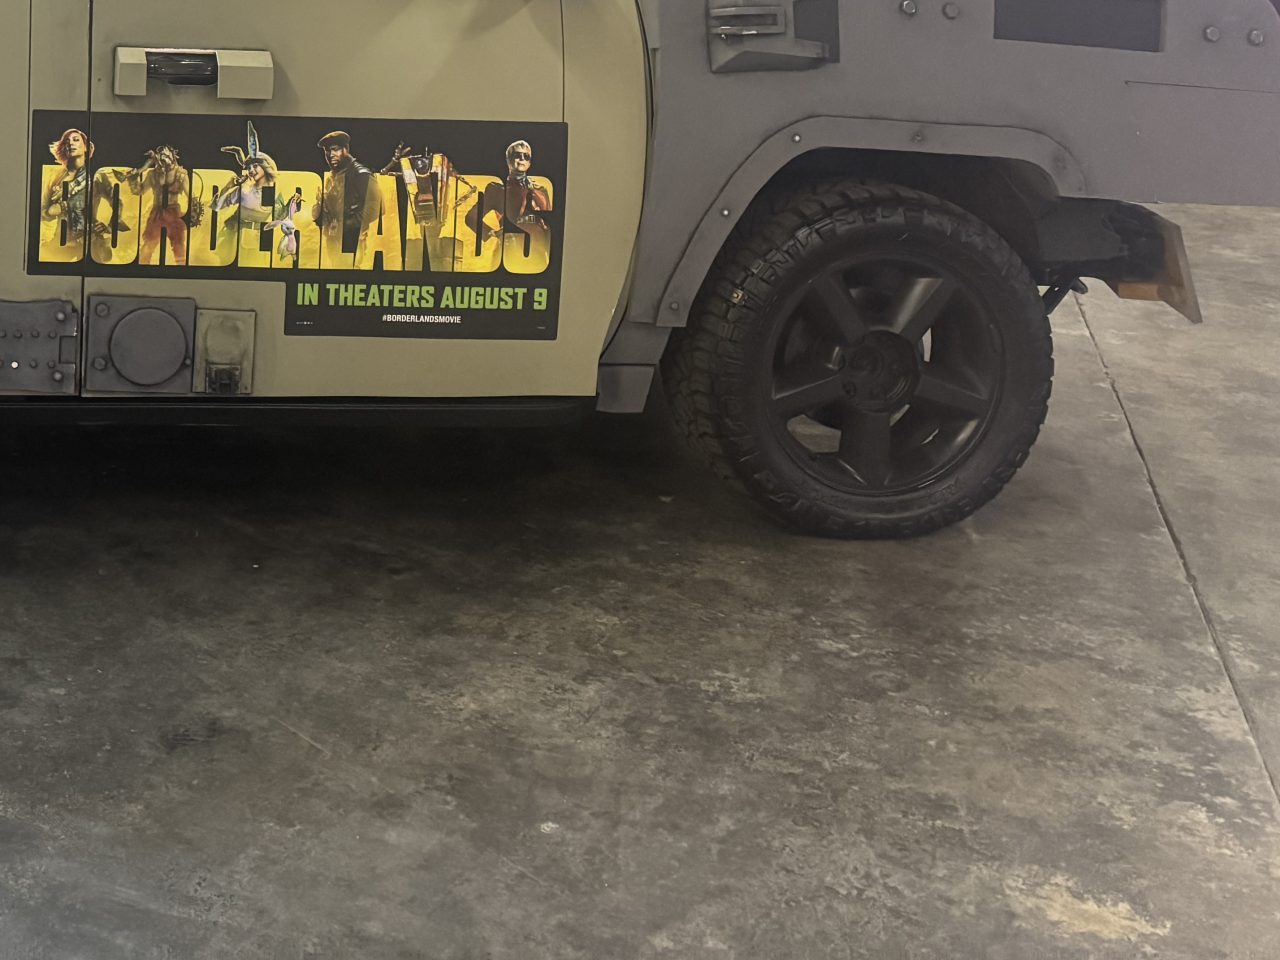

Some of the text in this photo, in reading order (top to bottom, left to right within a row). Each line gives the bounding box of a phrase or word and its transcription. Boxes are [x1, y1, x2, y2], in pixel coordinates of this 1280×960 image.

[38, 164, 554, 275] BORDERLANDS
[296, 283, 548, 311] IN THEATERS AUGUST 9
[382, 313, 462, 325] #BORDERLANDSMOVIE
